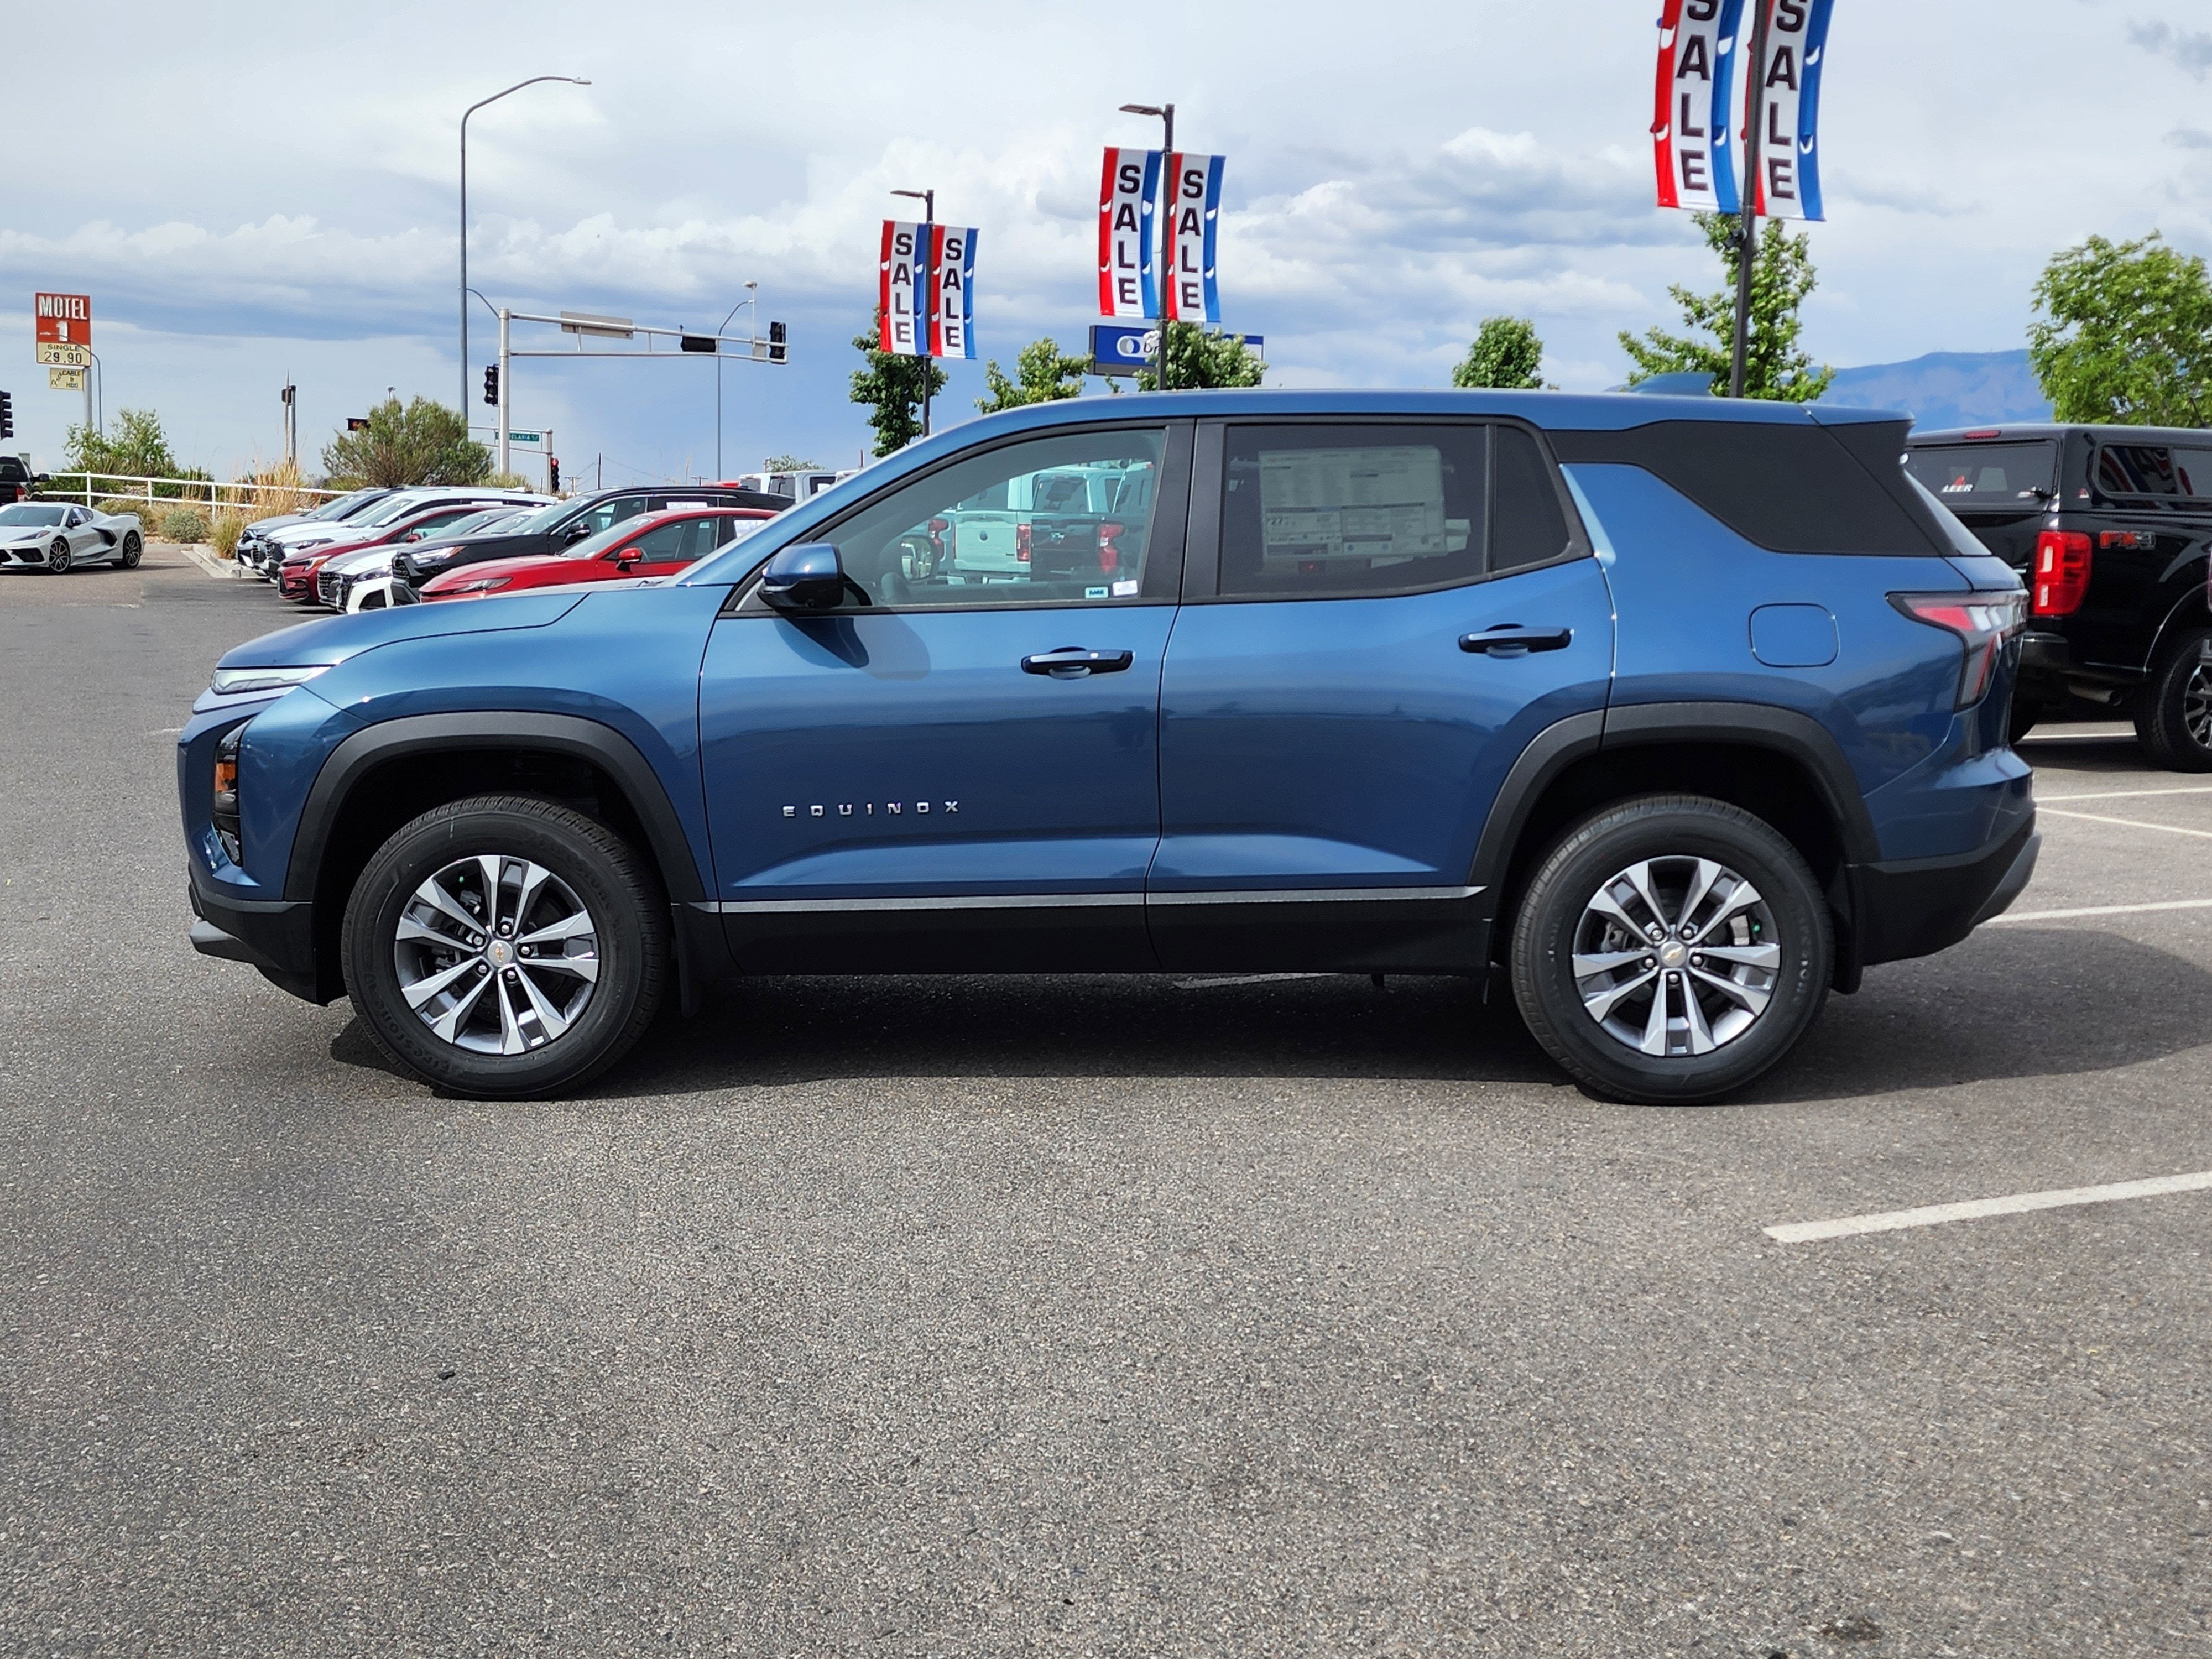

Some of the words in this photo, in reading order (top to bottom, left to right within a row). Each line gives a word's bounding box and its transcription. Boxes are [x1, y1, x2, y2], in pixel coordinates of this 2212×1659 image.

[1766, 0, 1807, 200] SALE
[1114, 164, 1141, 304] SALE
[1178, 169, 1204, 309] SALE
[38, 295, 87, 320] MOTEL
[891, 233, 913, 343] SALE
[942, 238, 963, 347] SALE
[56, 320, 68, 342] 1
[1940, 484, 1973, 493] LEER
[2100, 530, 2156, 550] FX4
[782, 801, 959, 817] EQUINOX
